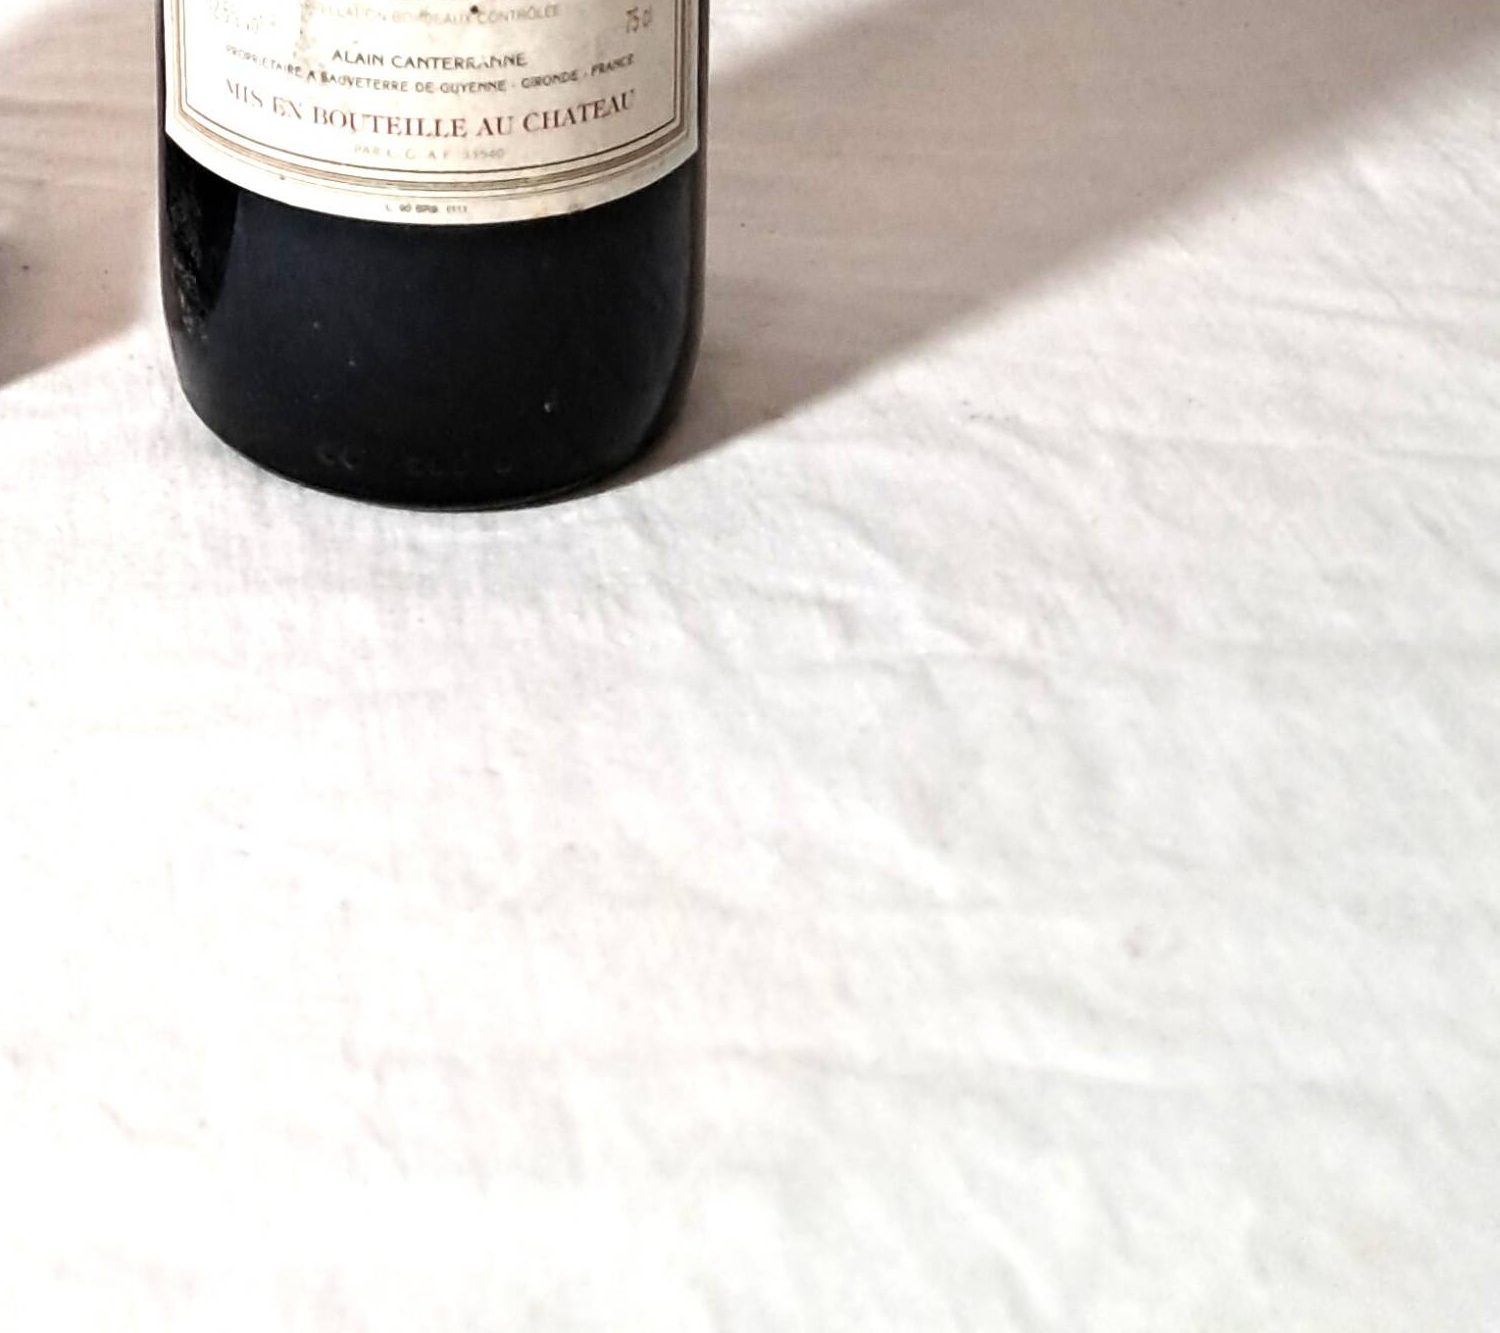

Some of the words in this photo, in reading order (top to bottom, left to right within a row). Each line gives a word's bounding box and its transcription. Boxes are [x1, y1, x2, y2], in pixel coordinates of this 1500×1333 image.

[332, 49, 384, 67] ALAIN
[415, 81, 435, 93] DE
[440, 79, 508, 94] GUYENNE
[520, 68, 579, 89] GIRONDE
[590, 52, 635, 78] FRANCE
[226, 78, 264, 109] MIS
[272, 95, 303, 121] EN
[313, 105, 468, 138] BOUTEILLE
[475, 116, 514, 137] AU
[522, 88, 636, 133] CHATEAU
